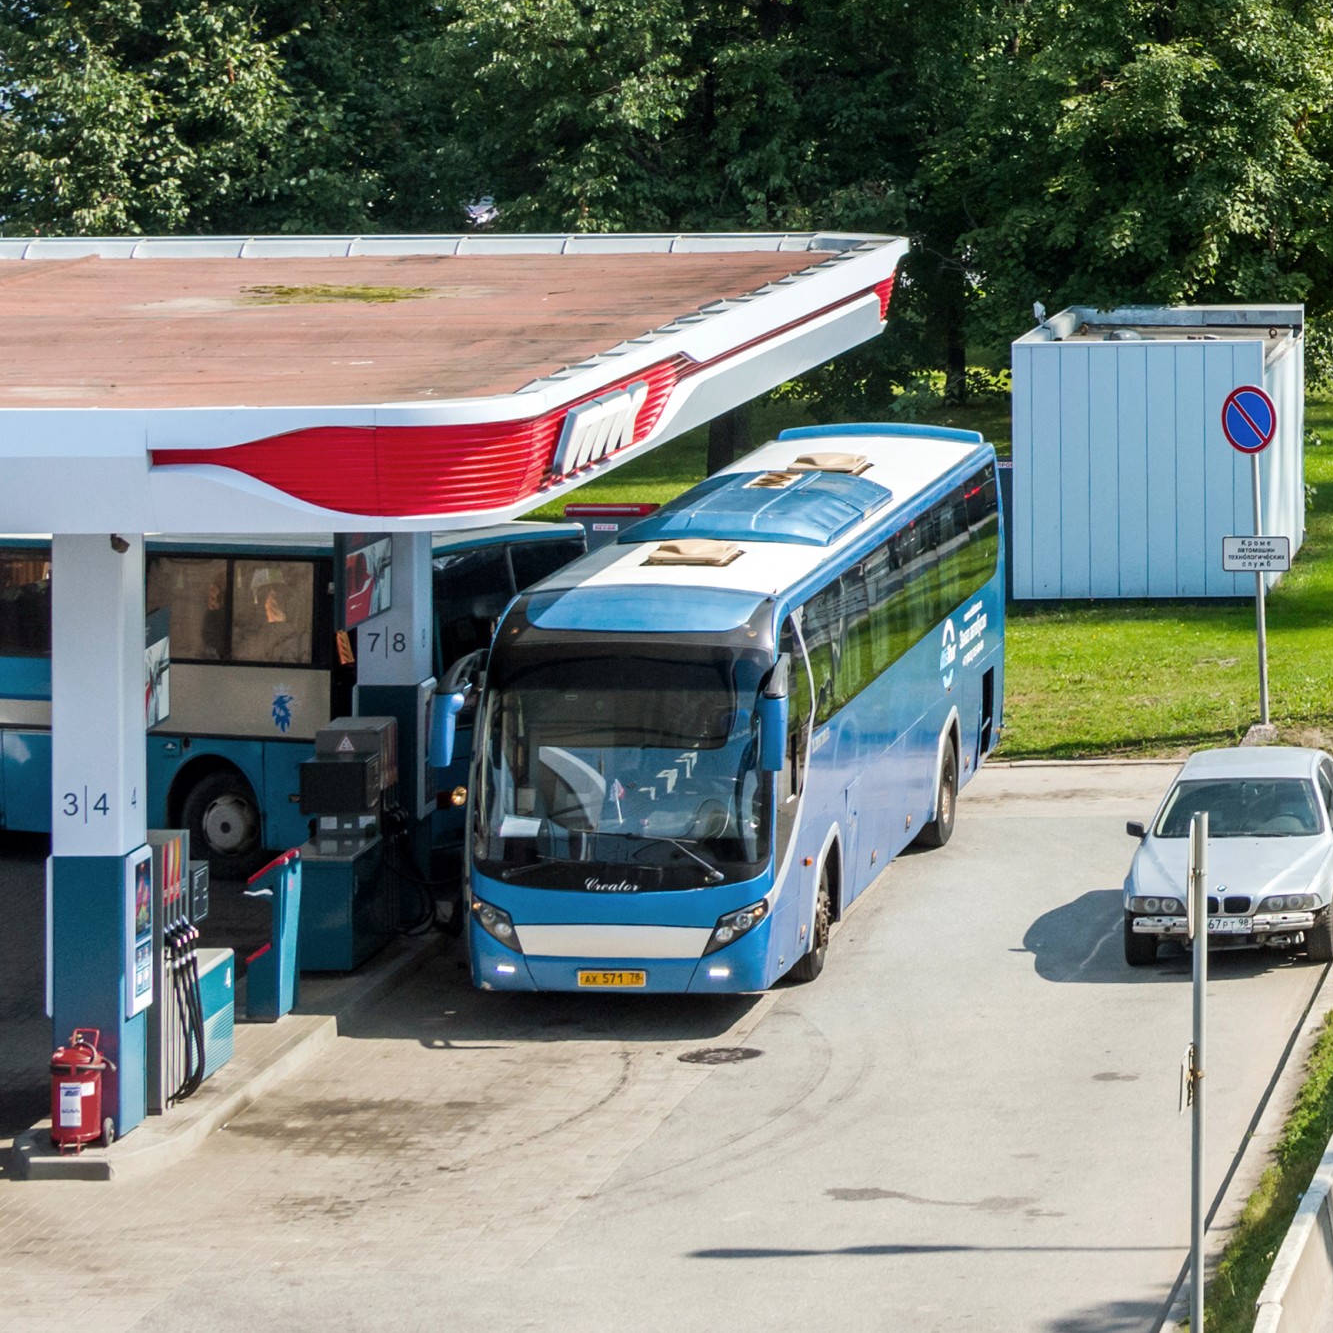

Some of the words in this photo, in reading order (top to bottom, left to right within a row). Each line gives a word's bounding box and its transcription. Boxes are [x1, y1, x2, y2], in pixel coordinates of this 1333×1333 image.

[1241, 560, 1271, 568] служб
[584, 877, 641, 891] Creator
[1208, 918, 1235, 929] 67РТ
[1238, 918, 1249, 926] 98
[224, 966, 232, 988] 4
[585, 974, 598, 984] АХ
[602, 972, 623, 984] 571
[629, 972, 641, 981] 78
